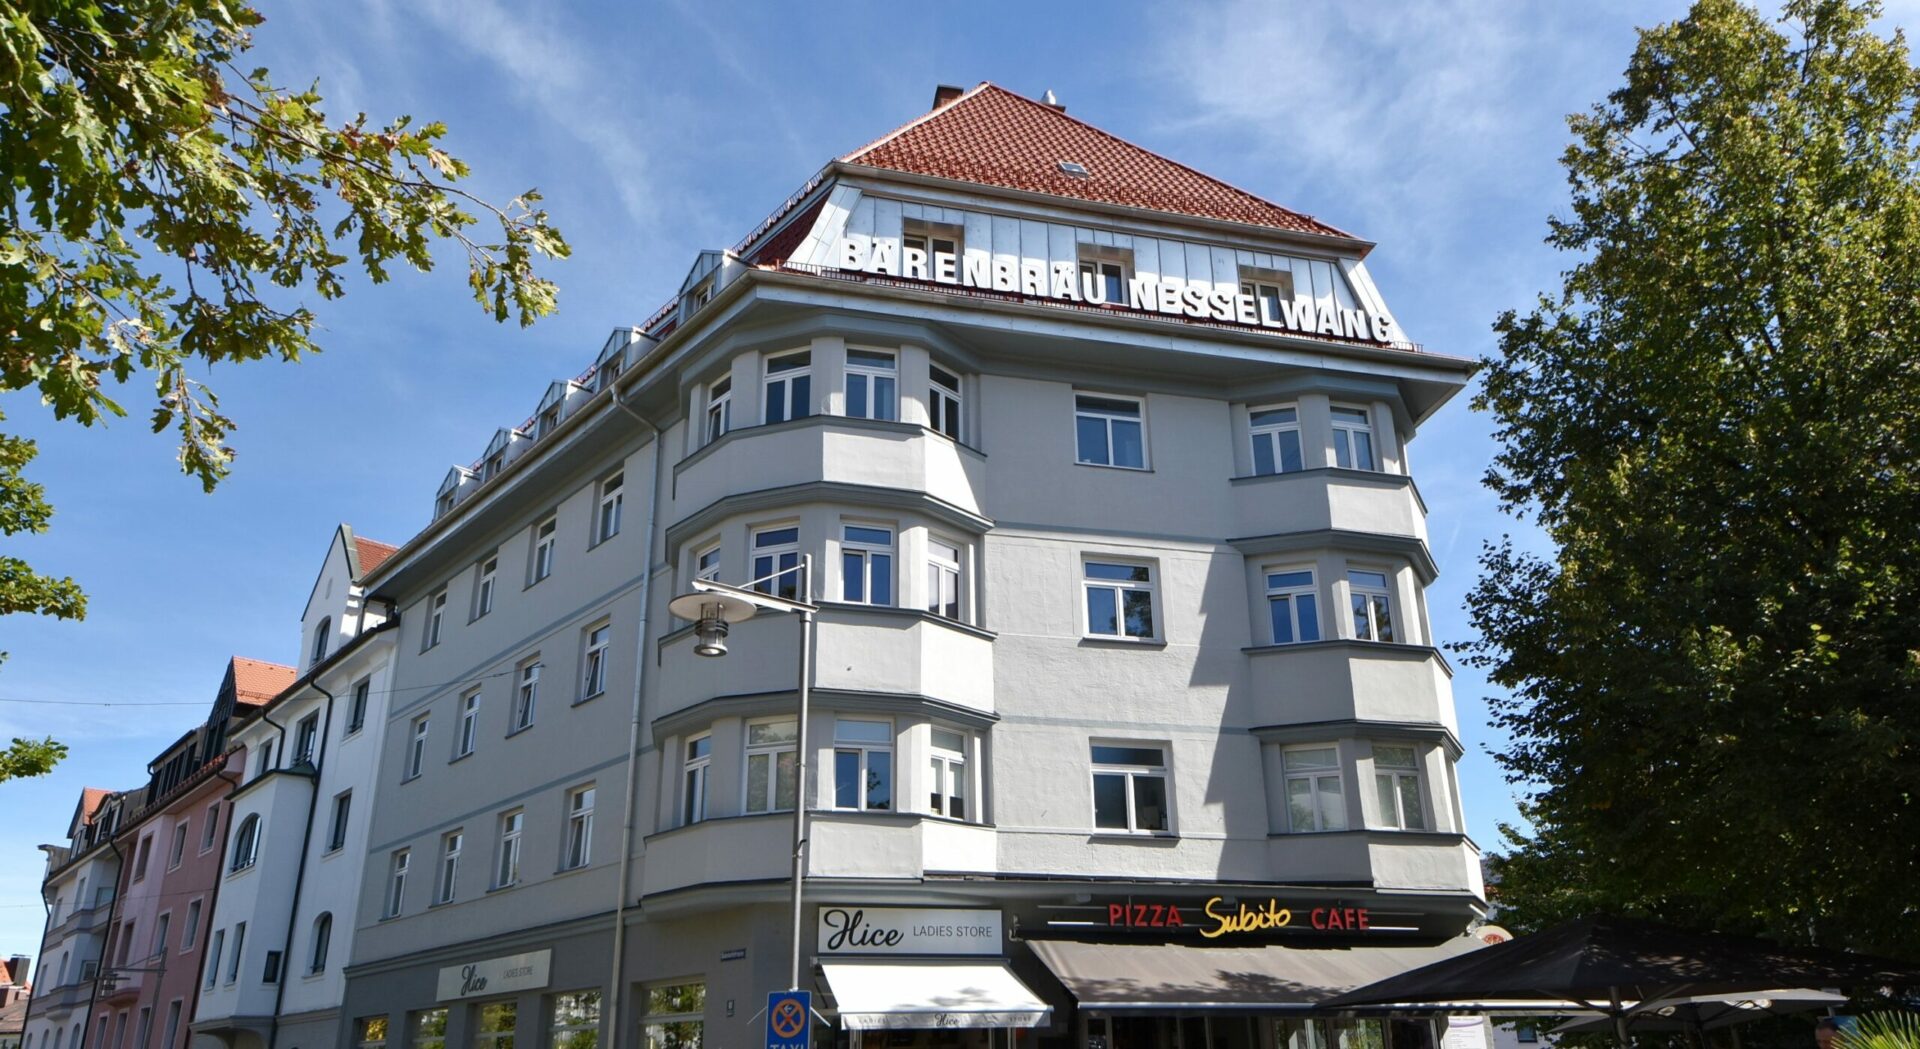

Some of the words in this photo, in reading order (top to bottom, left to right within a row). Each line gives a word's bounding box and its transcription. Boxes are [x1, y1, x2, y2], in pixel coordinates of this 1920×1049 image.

[839, 236, 1106, 305] BÄRENBRÄU
[1130, 278, 1394, 344] NESSELWANG
[913, 924, 953, 938] LADIES
[956, 925, 993, 938] STORE
[1108, 904, 1183, 928] PIZZA
[1200, 896, 1292, 938] Subito
[1311, 907, 1370, 930] CAFE
[503, 967, 519, 979] LADIES
[519, 965, 534, 976] STORE
